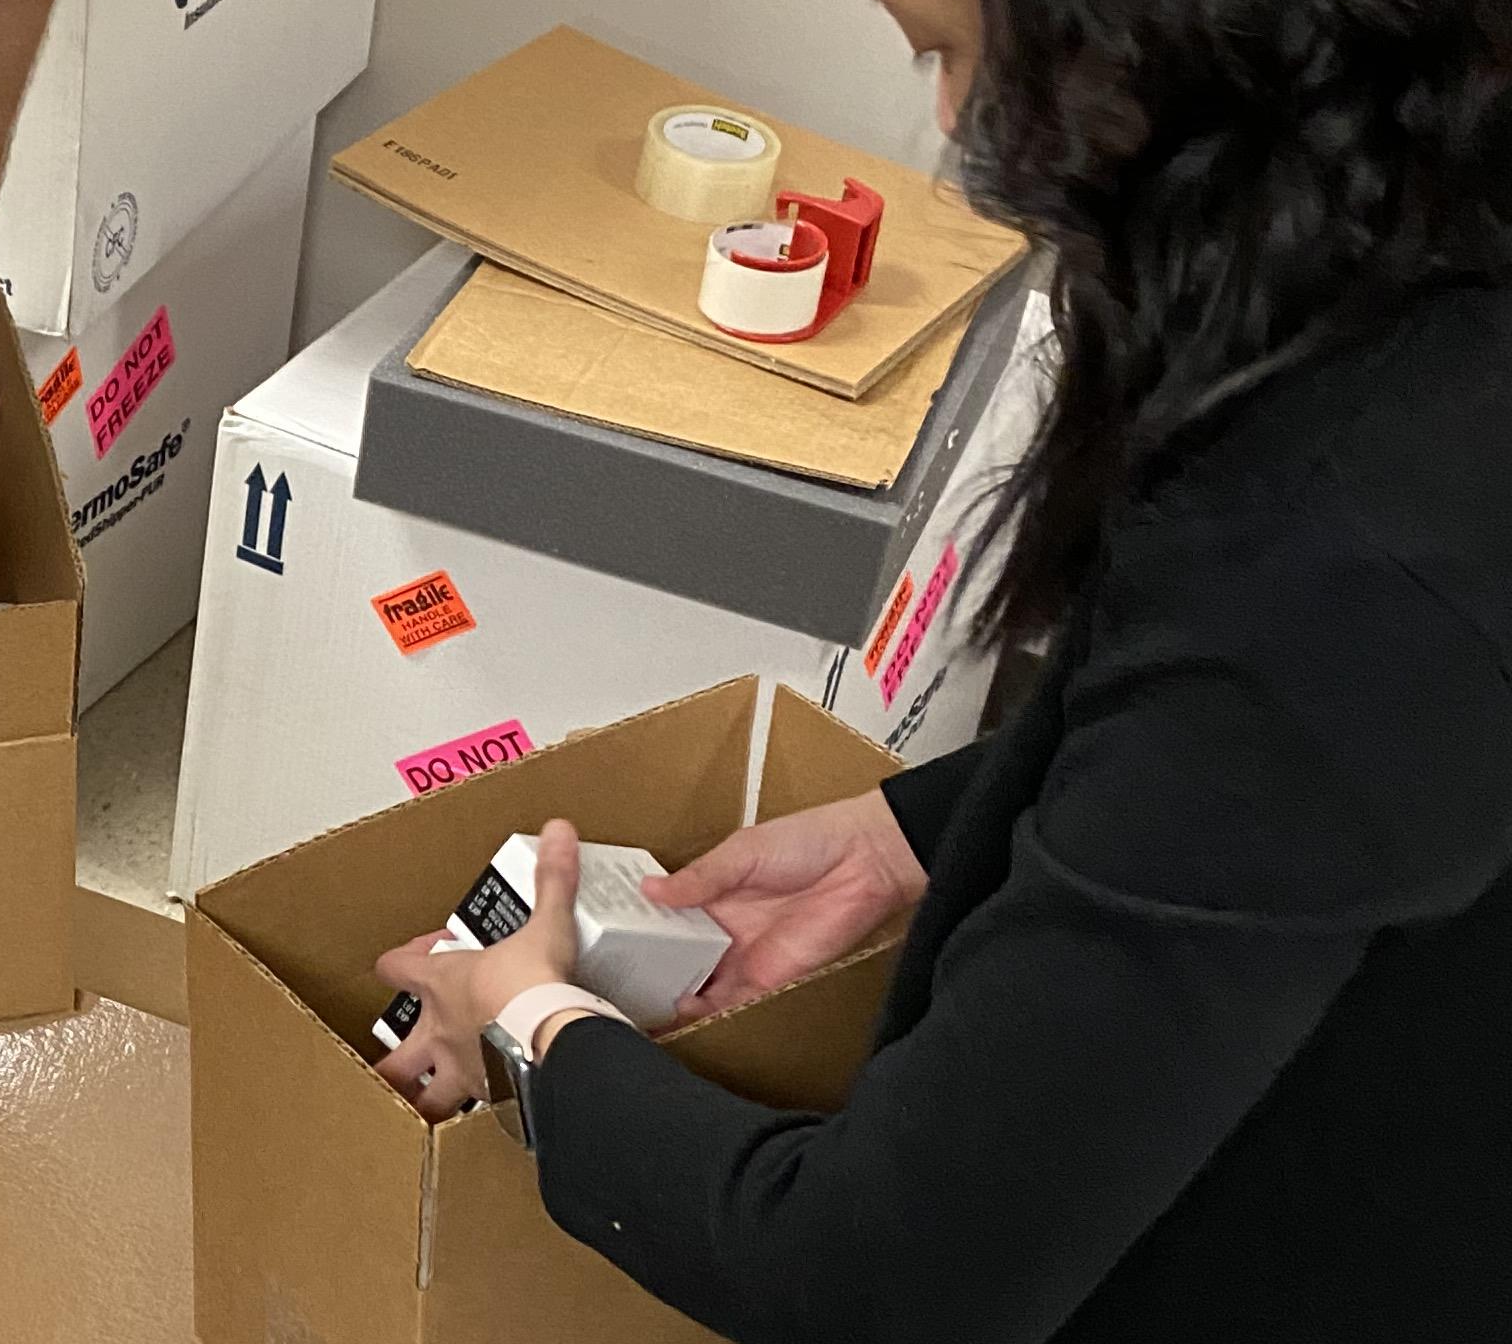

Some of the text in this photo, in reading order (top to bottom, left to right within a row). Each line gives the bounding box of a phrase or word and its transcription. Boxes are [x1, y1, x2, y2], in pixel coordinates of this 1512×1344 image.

[91, 317, 163, 423] DO NOT
[96, 344, 170, 451] FREEZE
[71, 432, 184, 533] ermoSafe
[383, 583, 455, 624] fragile
[400, 611, 468, 645] WITH CARE
[401, 605, 452, 631] HANDLE
[406, 730, 524, 793] DO NOT
